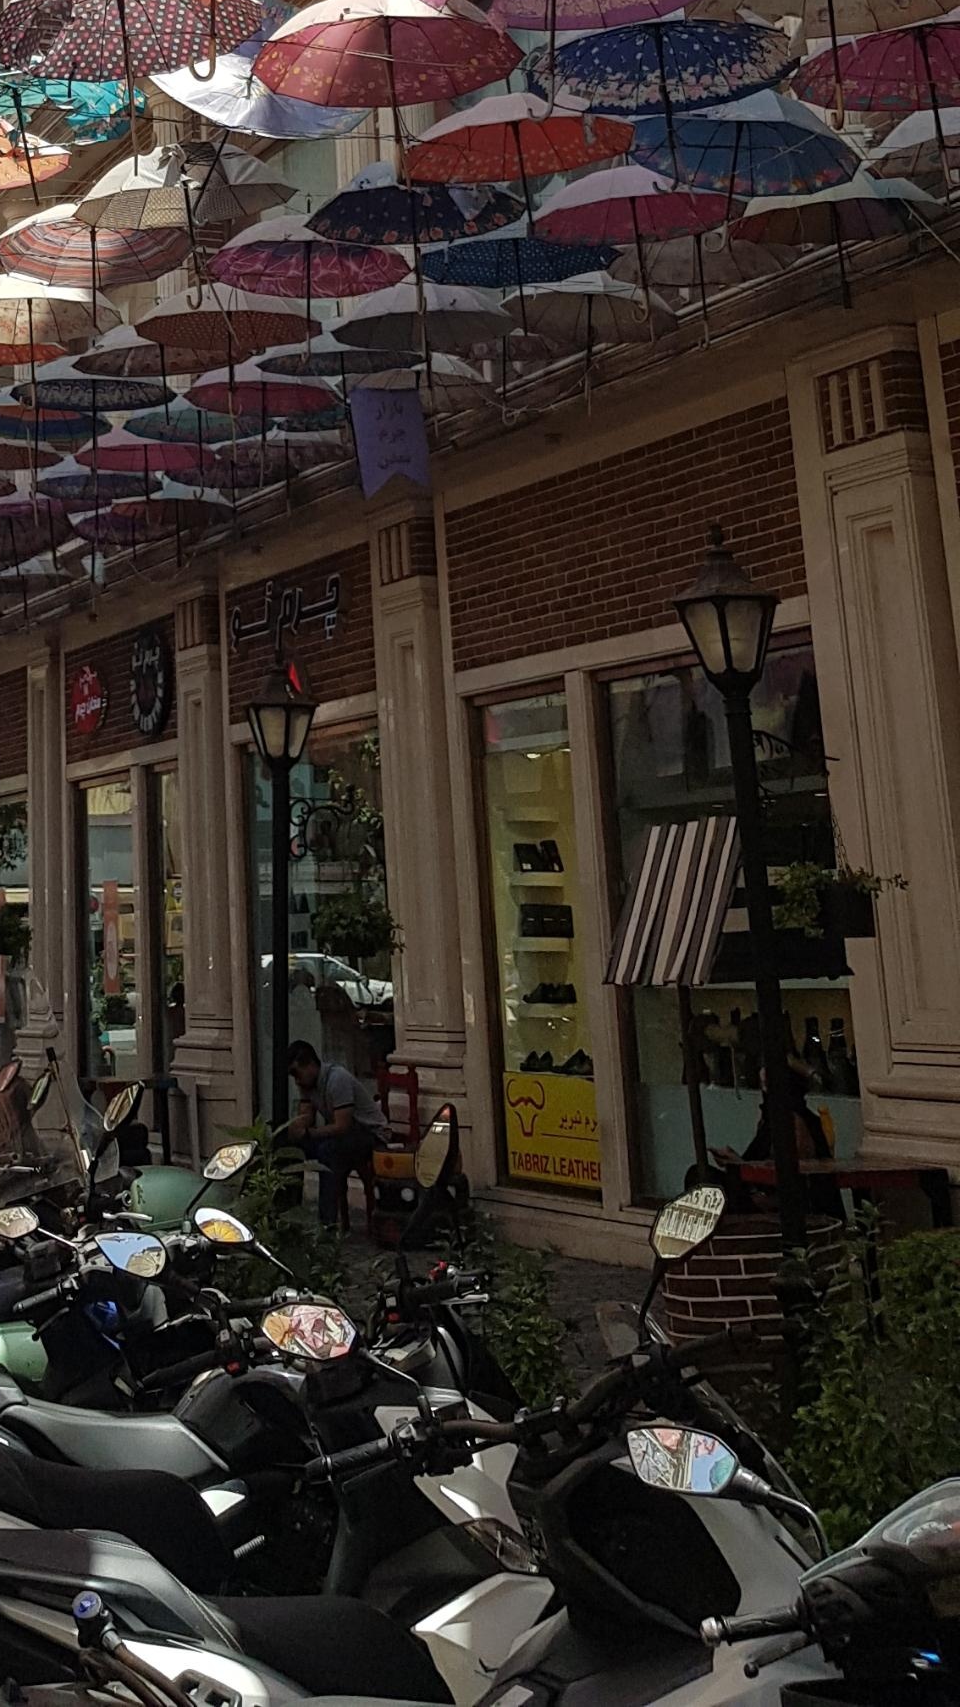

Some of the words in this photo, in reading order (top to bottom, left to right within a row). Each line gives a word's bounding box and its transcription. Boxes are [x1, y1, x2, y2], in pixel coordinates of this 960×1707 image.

[229, 581, 274, 653] نو
[275, 573, 340, 650] چرم
[511, 1151, 551, 1174] TABRIZ
